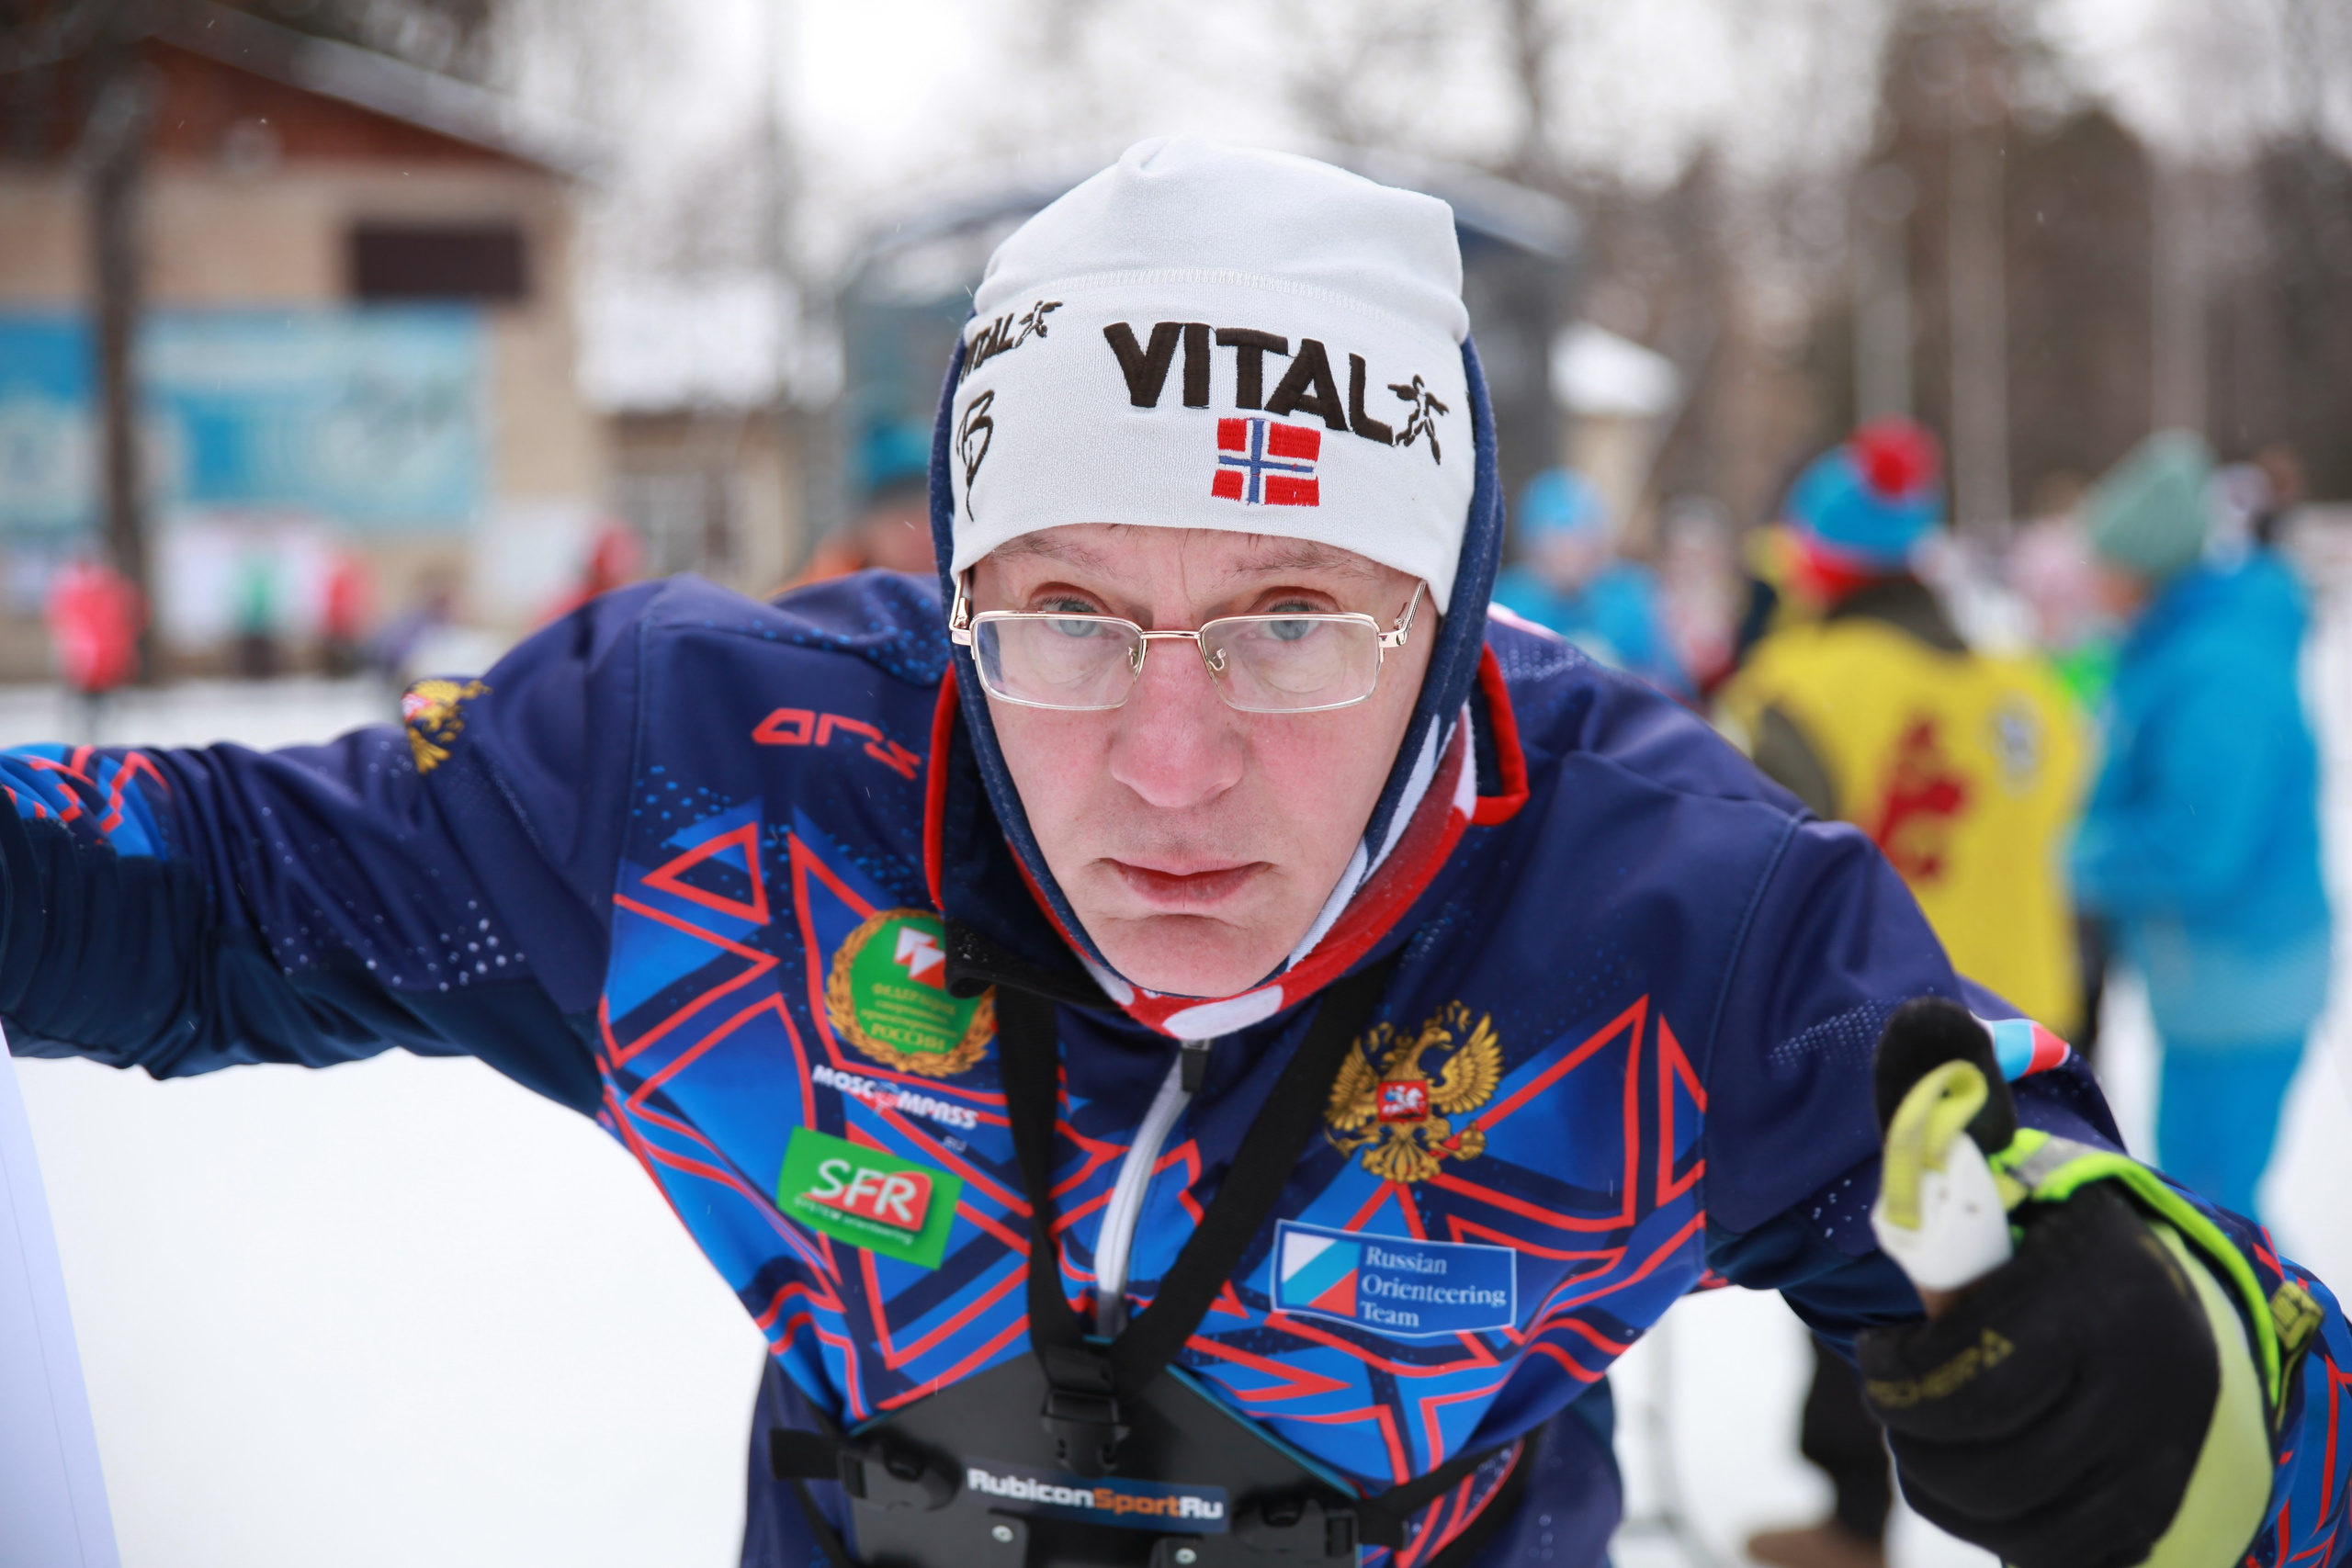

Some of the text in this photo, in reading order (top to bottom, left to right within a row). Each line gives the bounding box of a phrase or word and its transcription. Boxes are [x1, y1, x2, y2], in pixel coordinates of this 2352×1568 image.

[1102, 321, 1396, 447] VITAL
[810, 1158, 918, 1223] SFR
[1365, 1245, 1448, 1276] Russian
[1361, 1273, 1508, 1308] Orienteering
[1360, 1302, 1420, 1328] Team
[966, 1467, 1225, 1520] RubiconSportRu
